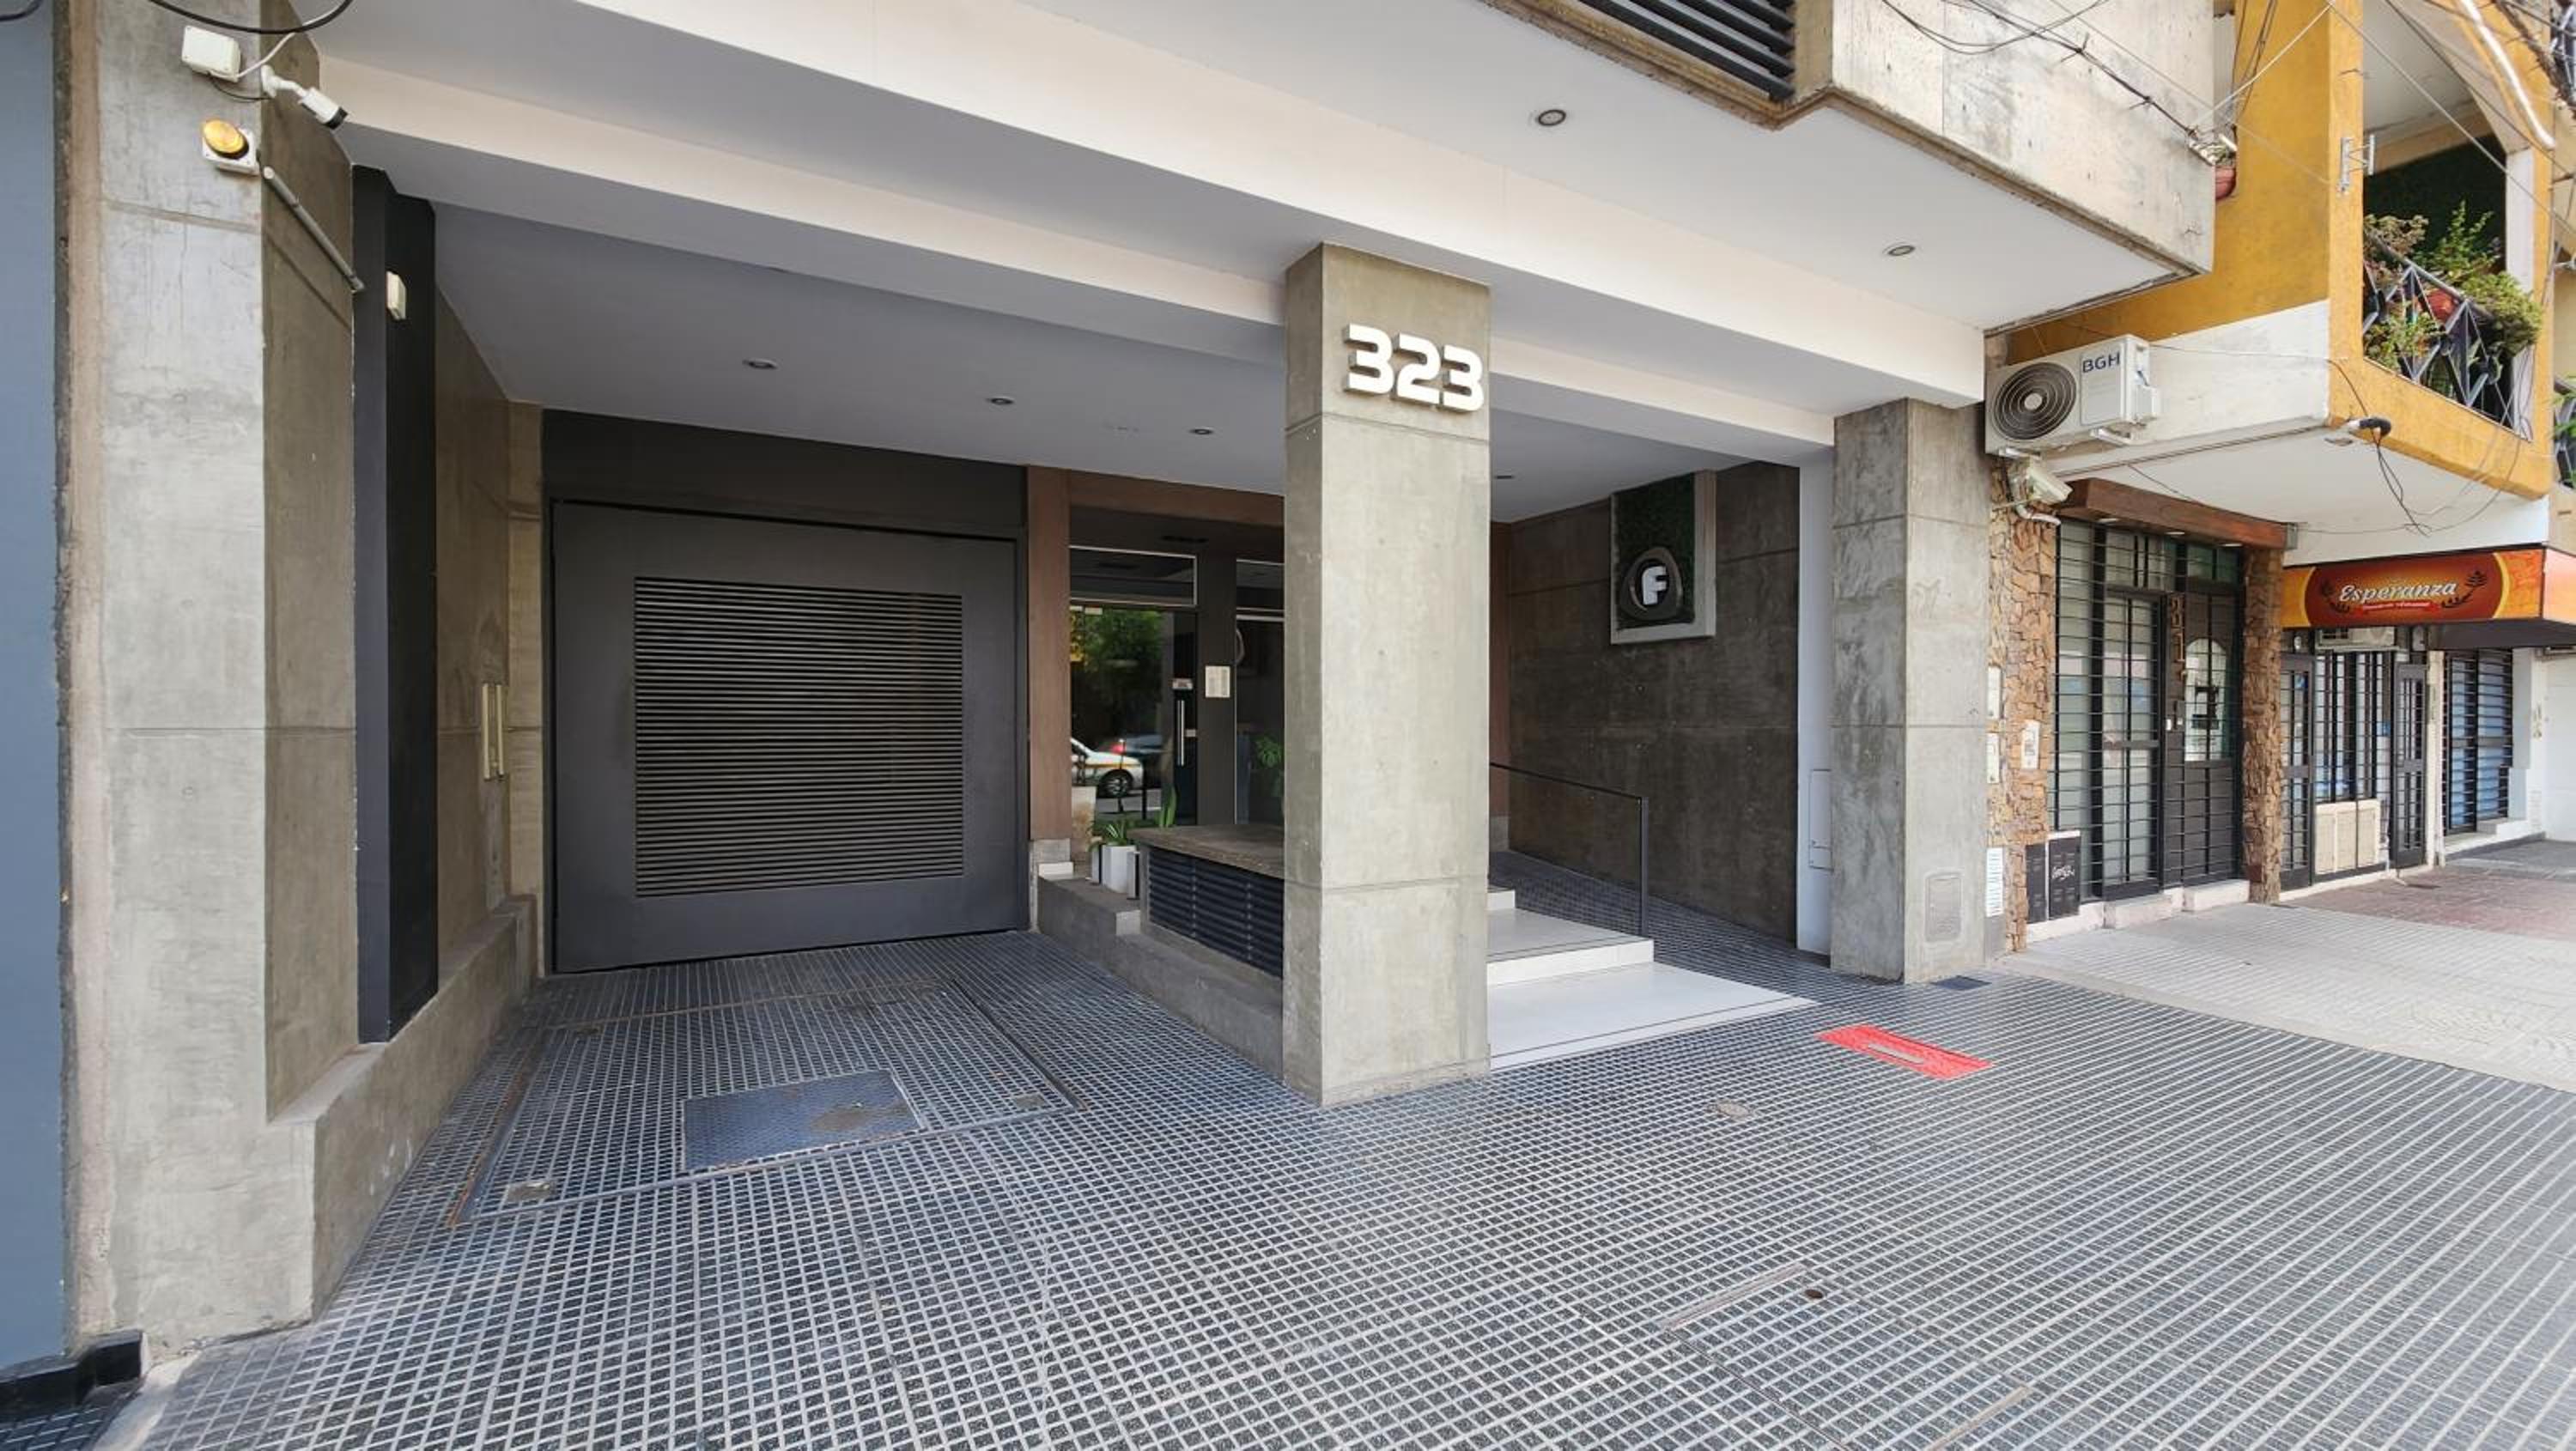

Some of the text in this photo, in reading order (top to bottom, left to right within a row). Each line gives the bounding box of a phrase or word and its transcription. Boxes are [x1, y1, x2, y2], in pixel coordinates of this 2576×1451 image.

[1346, 323, 1485, 412] 323
[2082, 351, 2120, 373] BGH
[1641, 565, 1668, 606] F
[2338, 581, 2458, 604] Esperanza
